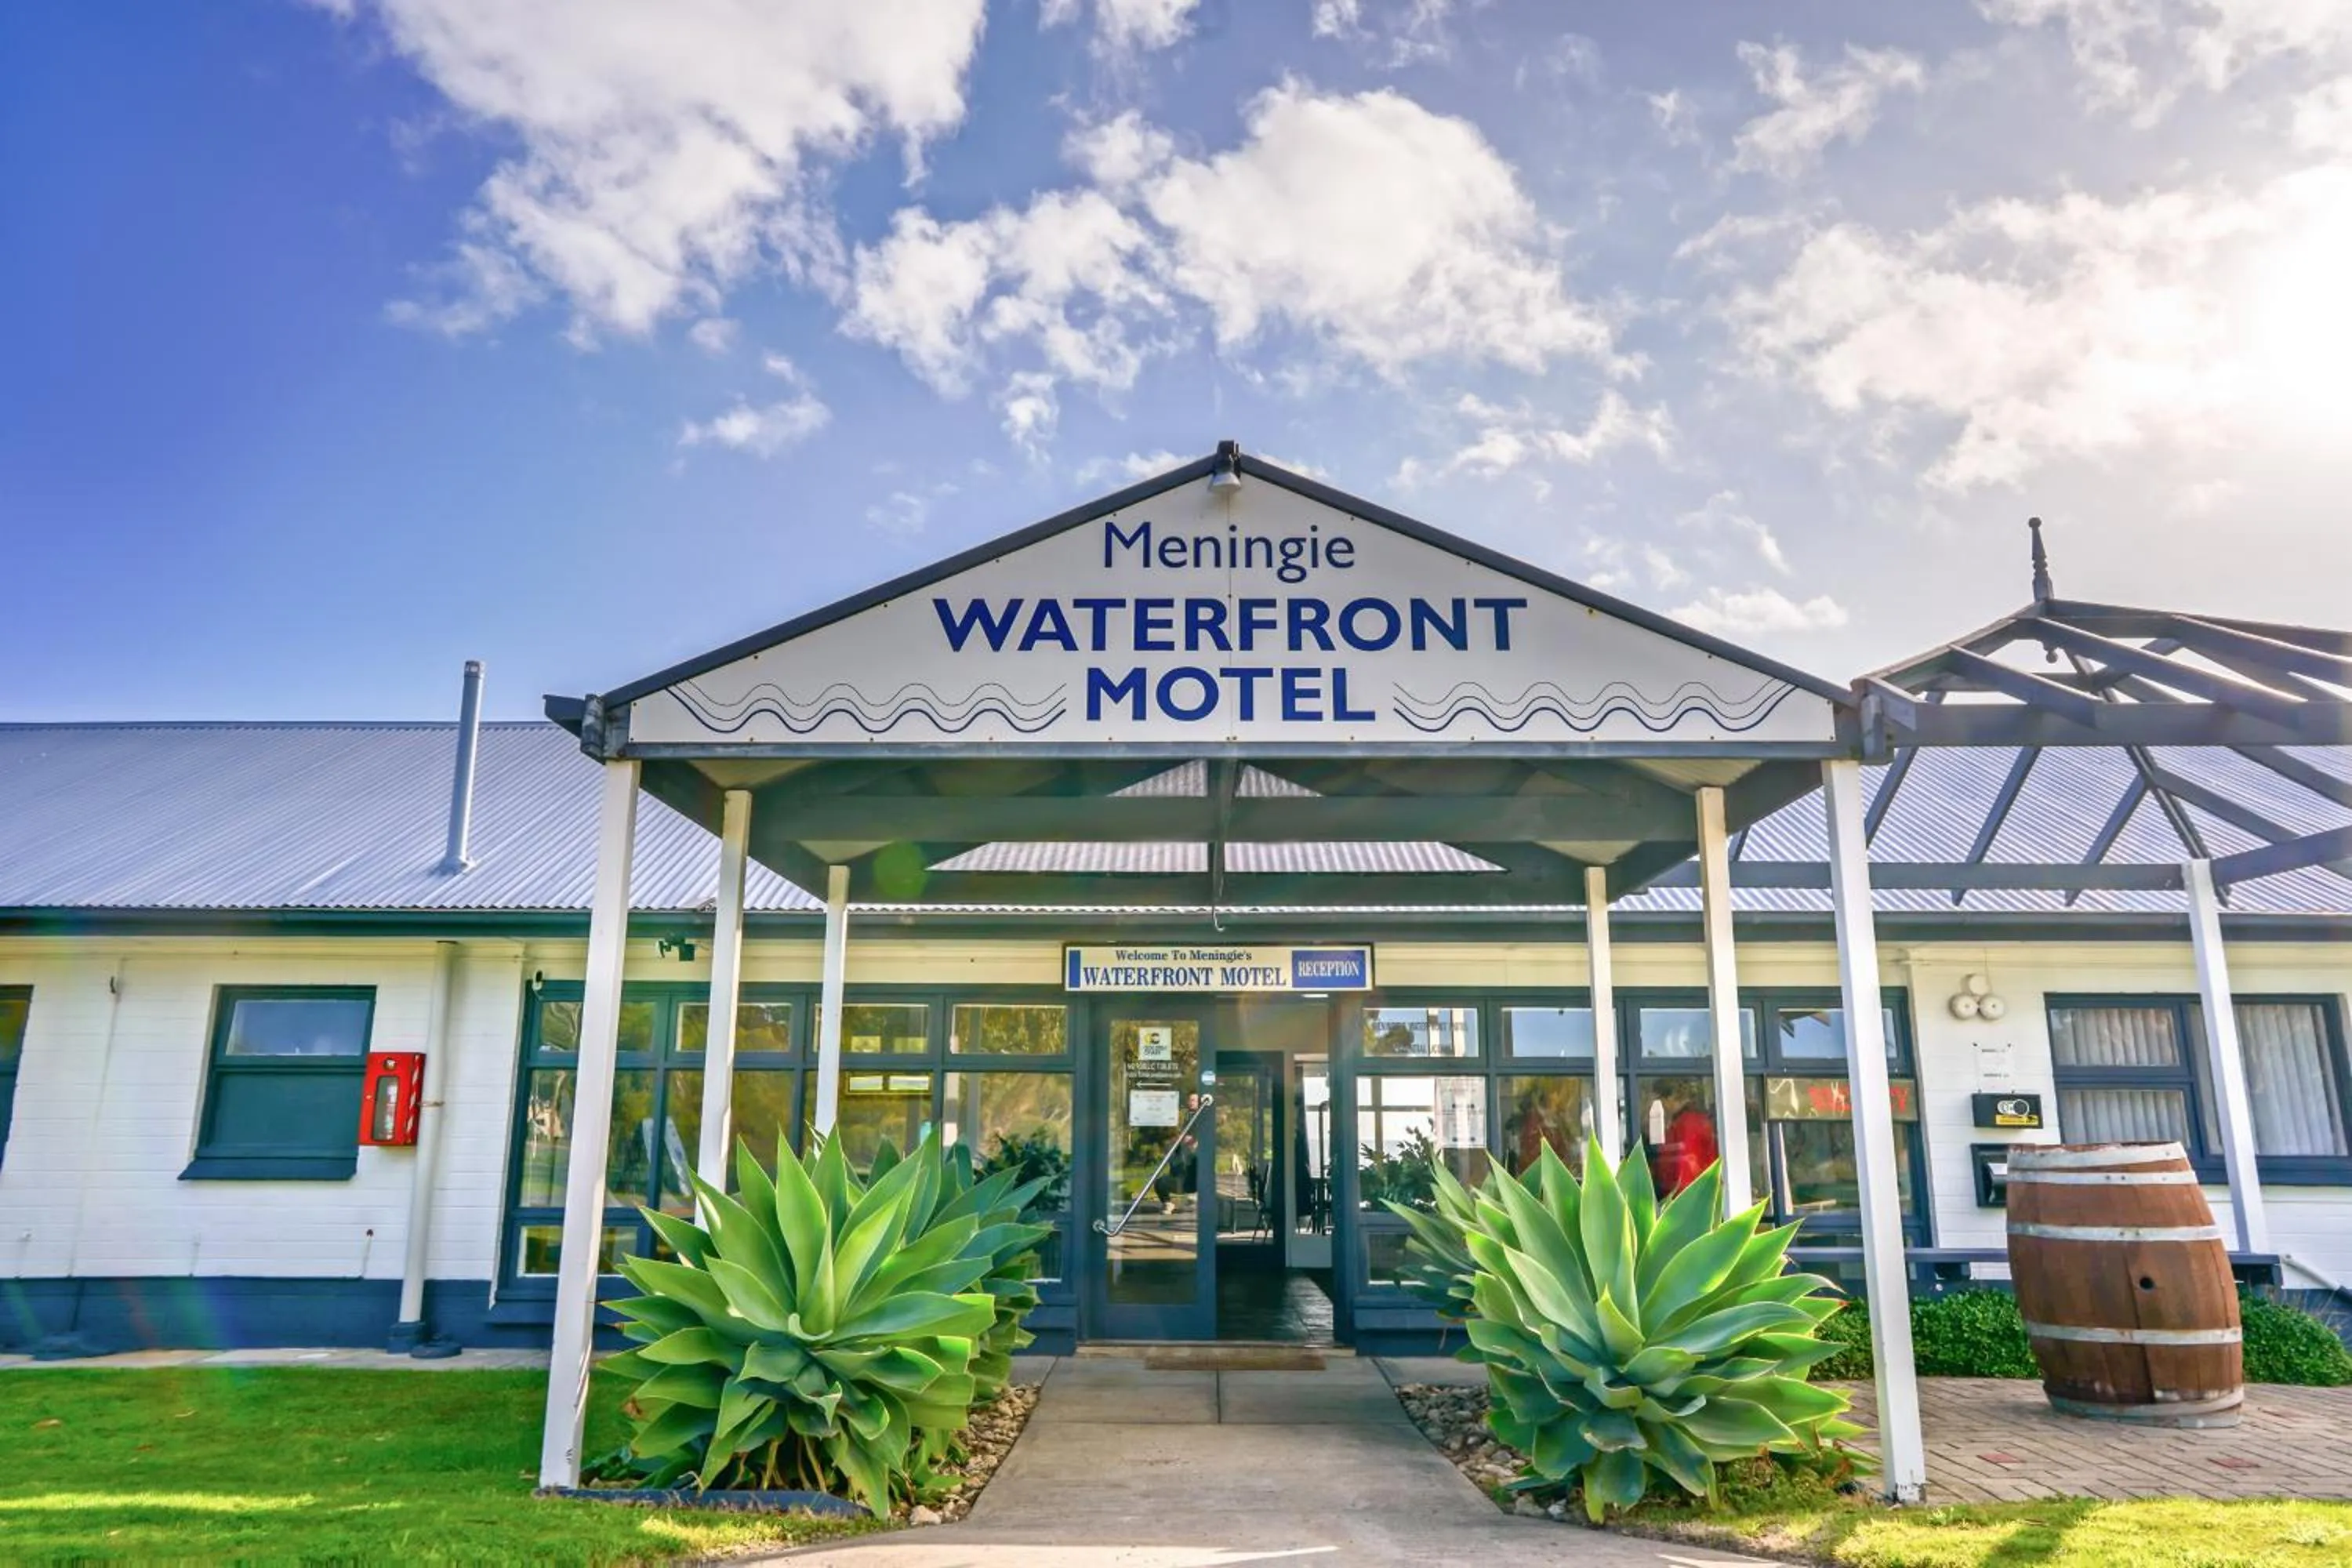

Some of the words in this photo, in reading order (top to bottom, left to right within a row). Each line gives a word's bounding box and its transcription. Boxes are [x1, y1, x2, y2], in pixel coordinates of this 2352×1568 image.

[1104, 521, 1355, 583] Meningie
[933, 597, 1527, 652] WATERFRONT
[1087, 667, 1376, 722] MOTEL
[1116, 949, 1168, 960] Welcome
[1171, 949, 1186, 960] To
[1189, 949, 1252, 964] Meningie's
[1298, 960, 1359, 978] RECEPTION
[1083, 967, 1213, 985] WATERFRONT
[1220, 967, 1287, 986] MOTEL
